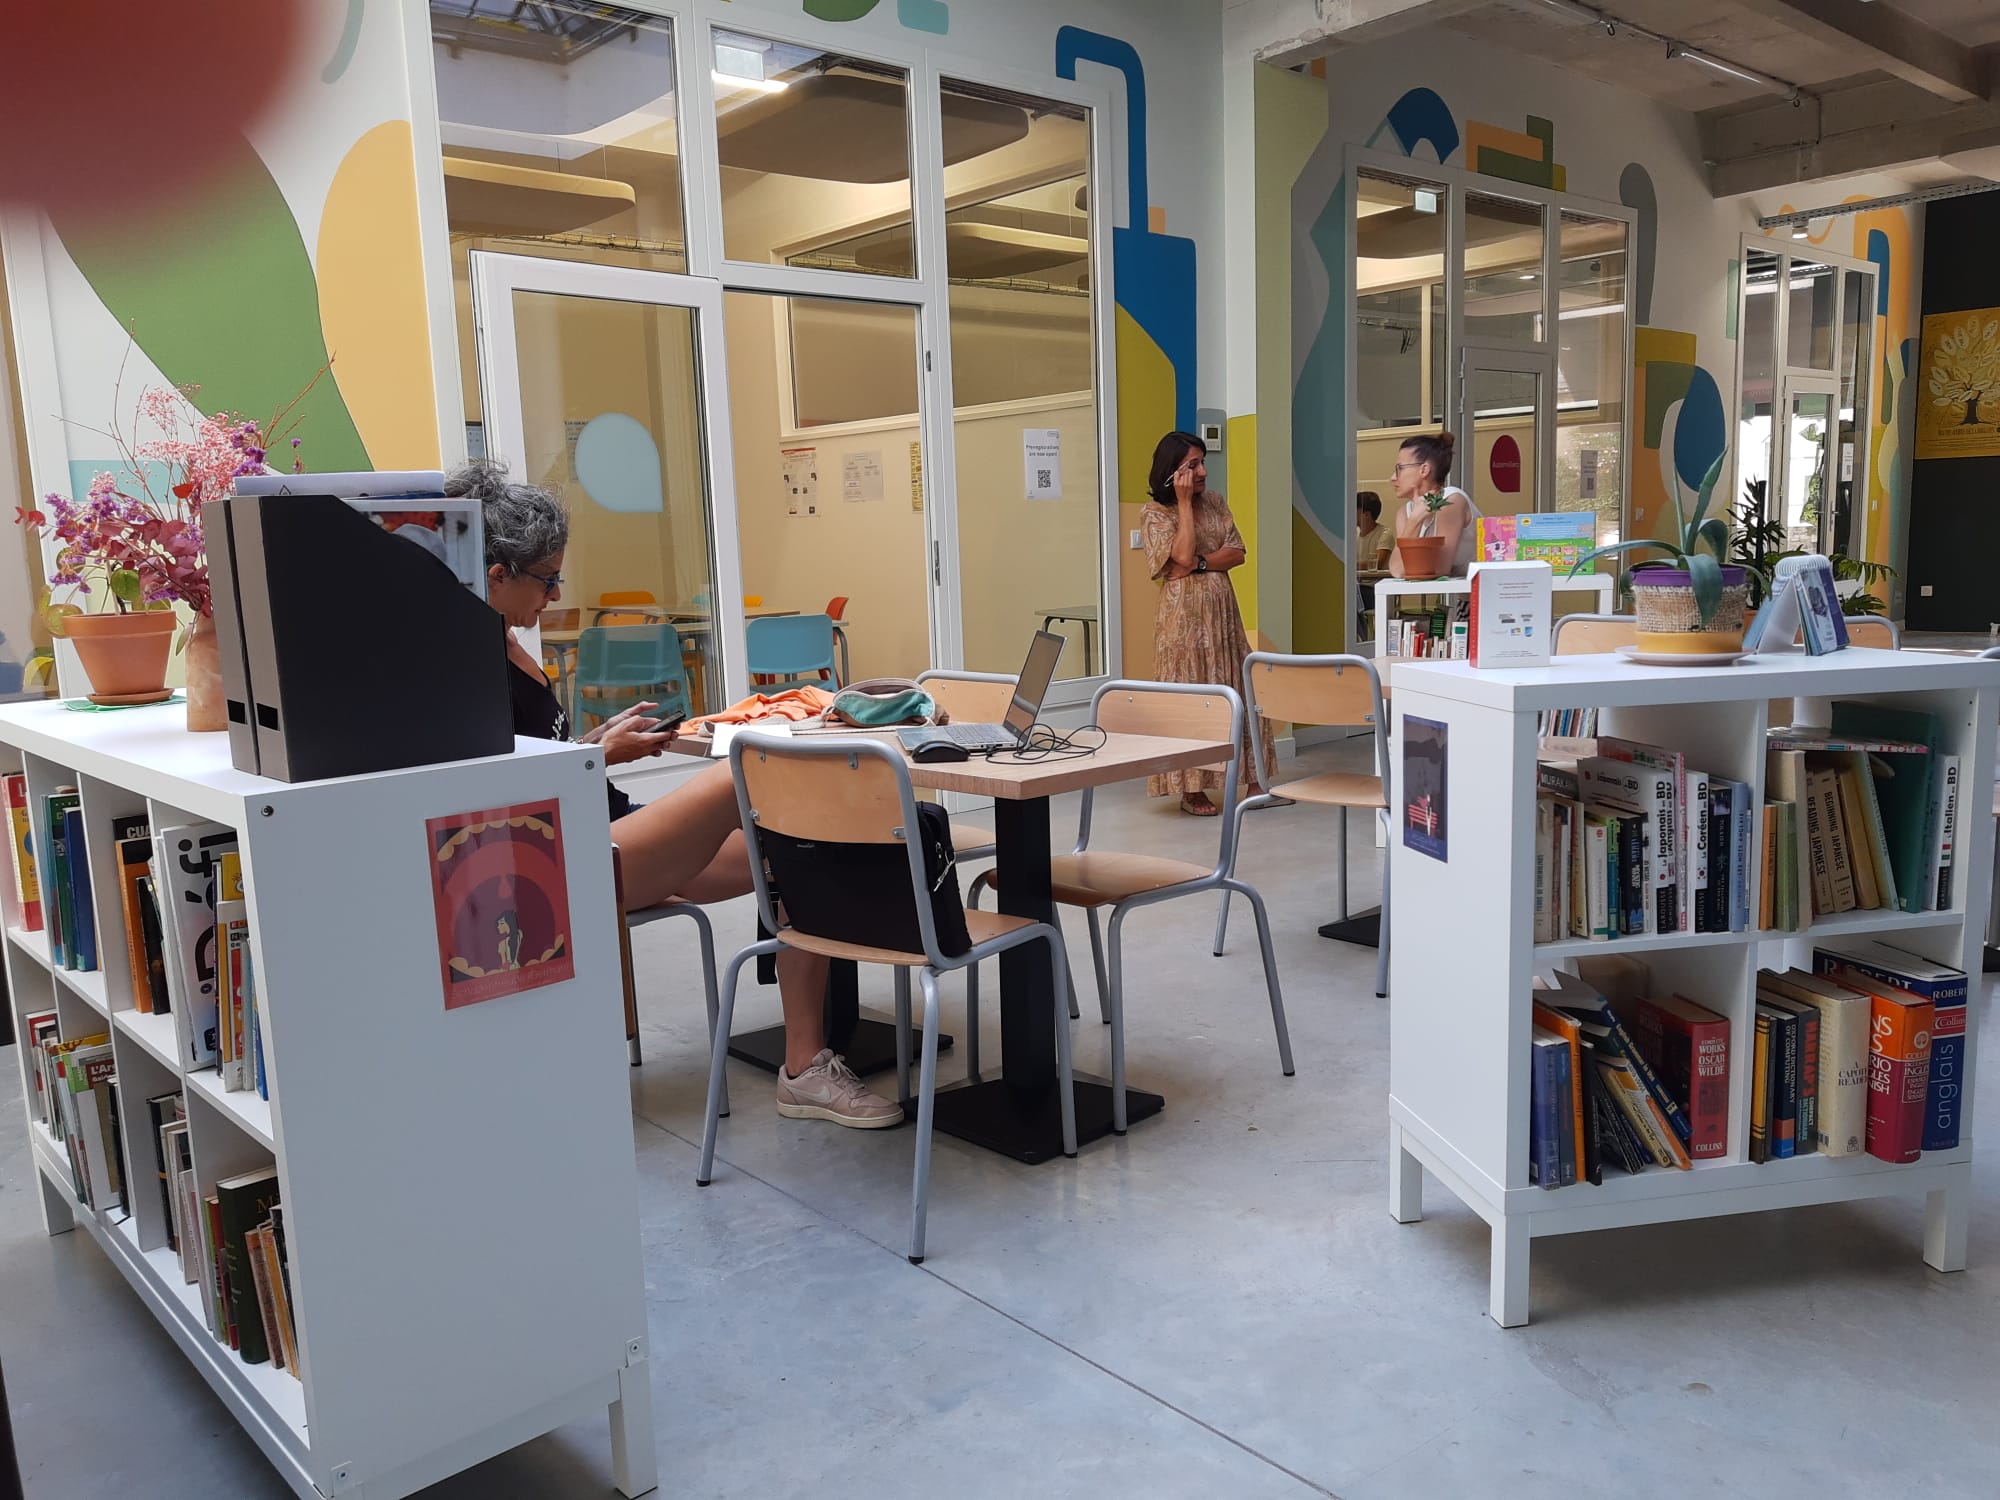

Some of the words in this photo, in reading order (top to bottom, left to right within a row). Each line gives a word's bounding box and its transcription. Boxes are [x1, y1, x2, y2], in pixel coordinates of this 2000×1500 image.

[1947, 766, 1957, 785] BD
[1656, 781, 1666, 799] BD
[1698, 782, 1707, 800] BD
[1807, 796, 1820, 833] READING
[1656, 809, 1668, 859] Japonais
[1697, 809, 1707, 851] Coréen
[1823, 791, 1838, 833] BEGINNING
[1831, 834, 1845, 872] JAPANESE
[1812, 836, 1826, 877] JAPANESE
[1628, 1042, 1646, 1064] Grammar
[1698, 1043, 1726, 1055] WORKS
[1698, 1053, 1725, 1066] OSCAR
[1804, 1021, 1818, 1097] HARRAP'S
[1698, 1066, 1725, 1077] WILDE
[1930, 1043, 1958, 1129] anglais
[1695, 1142, 1723, 1153] COLLINS
